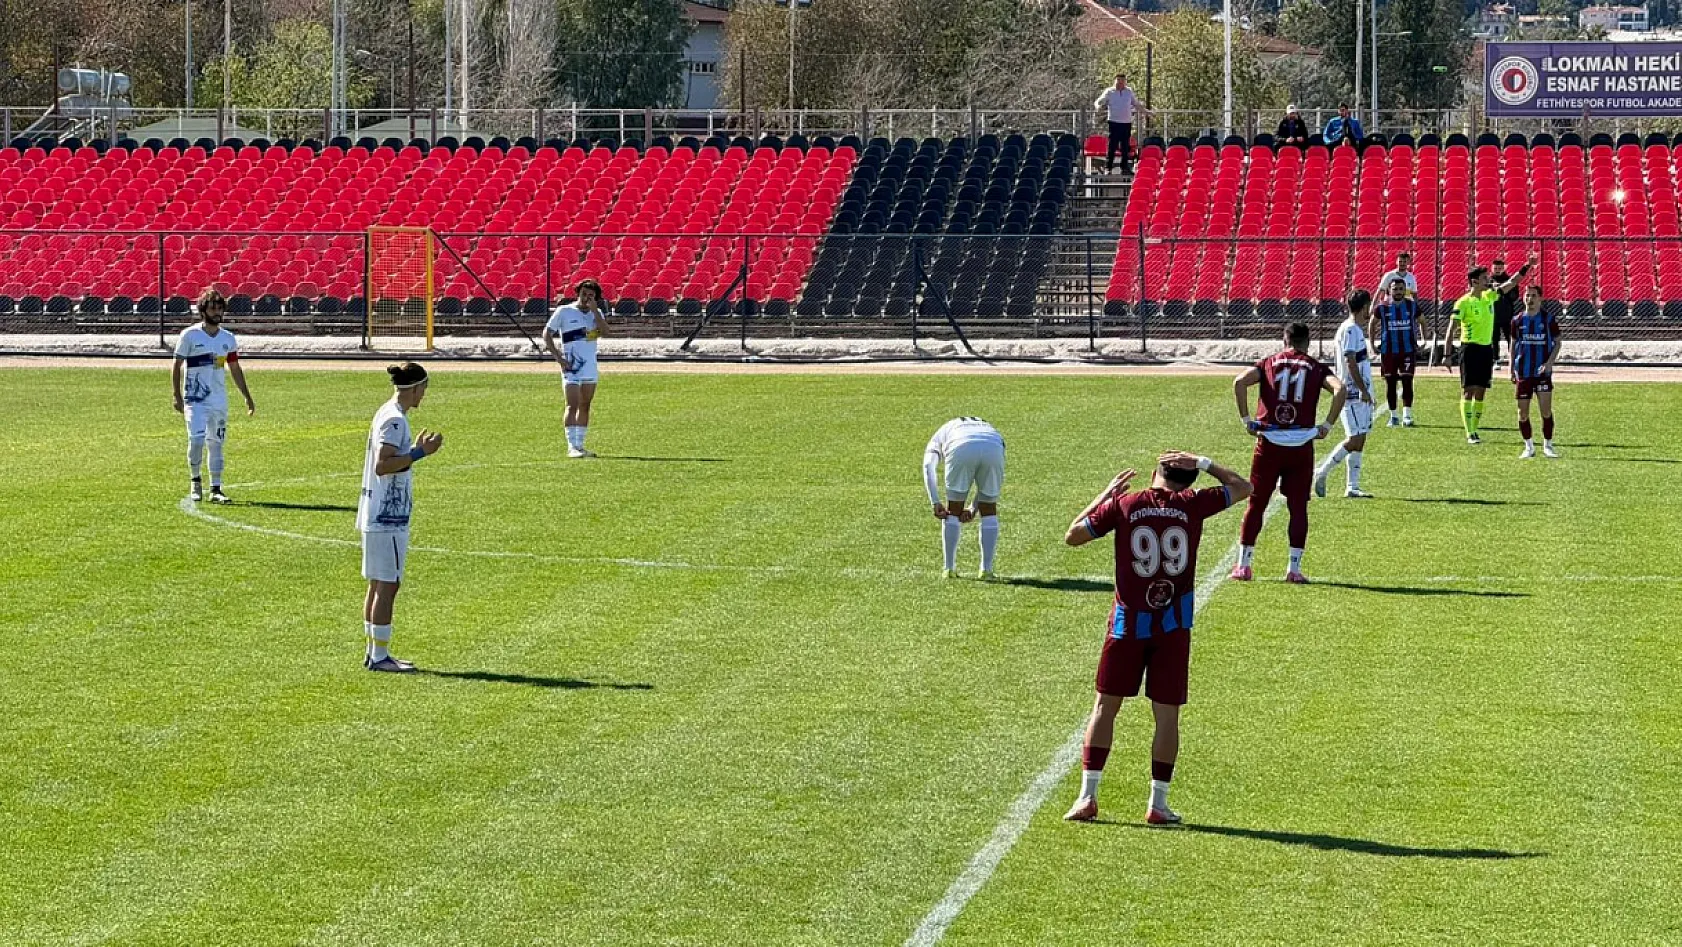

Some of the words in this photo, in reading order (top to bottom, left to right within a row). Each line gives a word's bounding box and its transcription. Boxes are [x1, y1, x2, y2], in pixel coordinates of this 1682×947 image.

[1547, 57, 1628, 72] LOKMAN
[1634, 52, 1680, 72] HEKİ
[1547, 76, 1599, 92] ESNAF
[1605, 76, 1682, 92] HASTANE
[1607, 98, 1645, 108] FUTBOL
[1647, 98, 1682, 107] AKADE
[1404, 363, 1411, 371] 7
[1274, 367, 1307, 403] 11
[1131, 525, 1189, 577] 99
